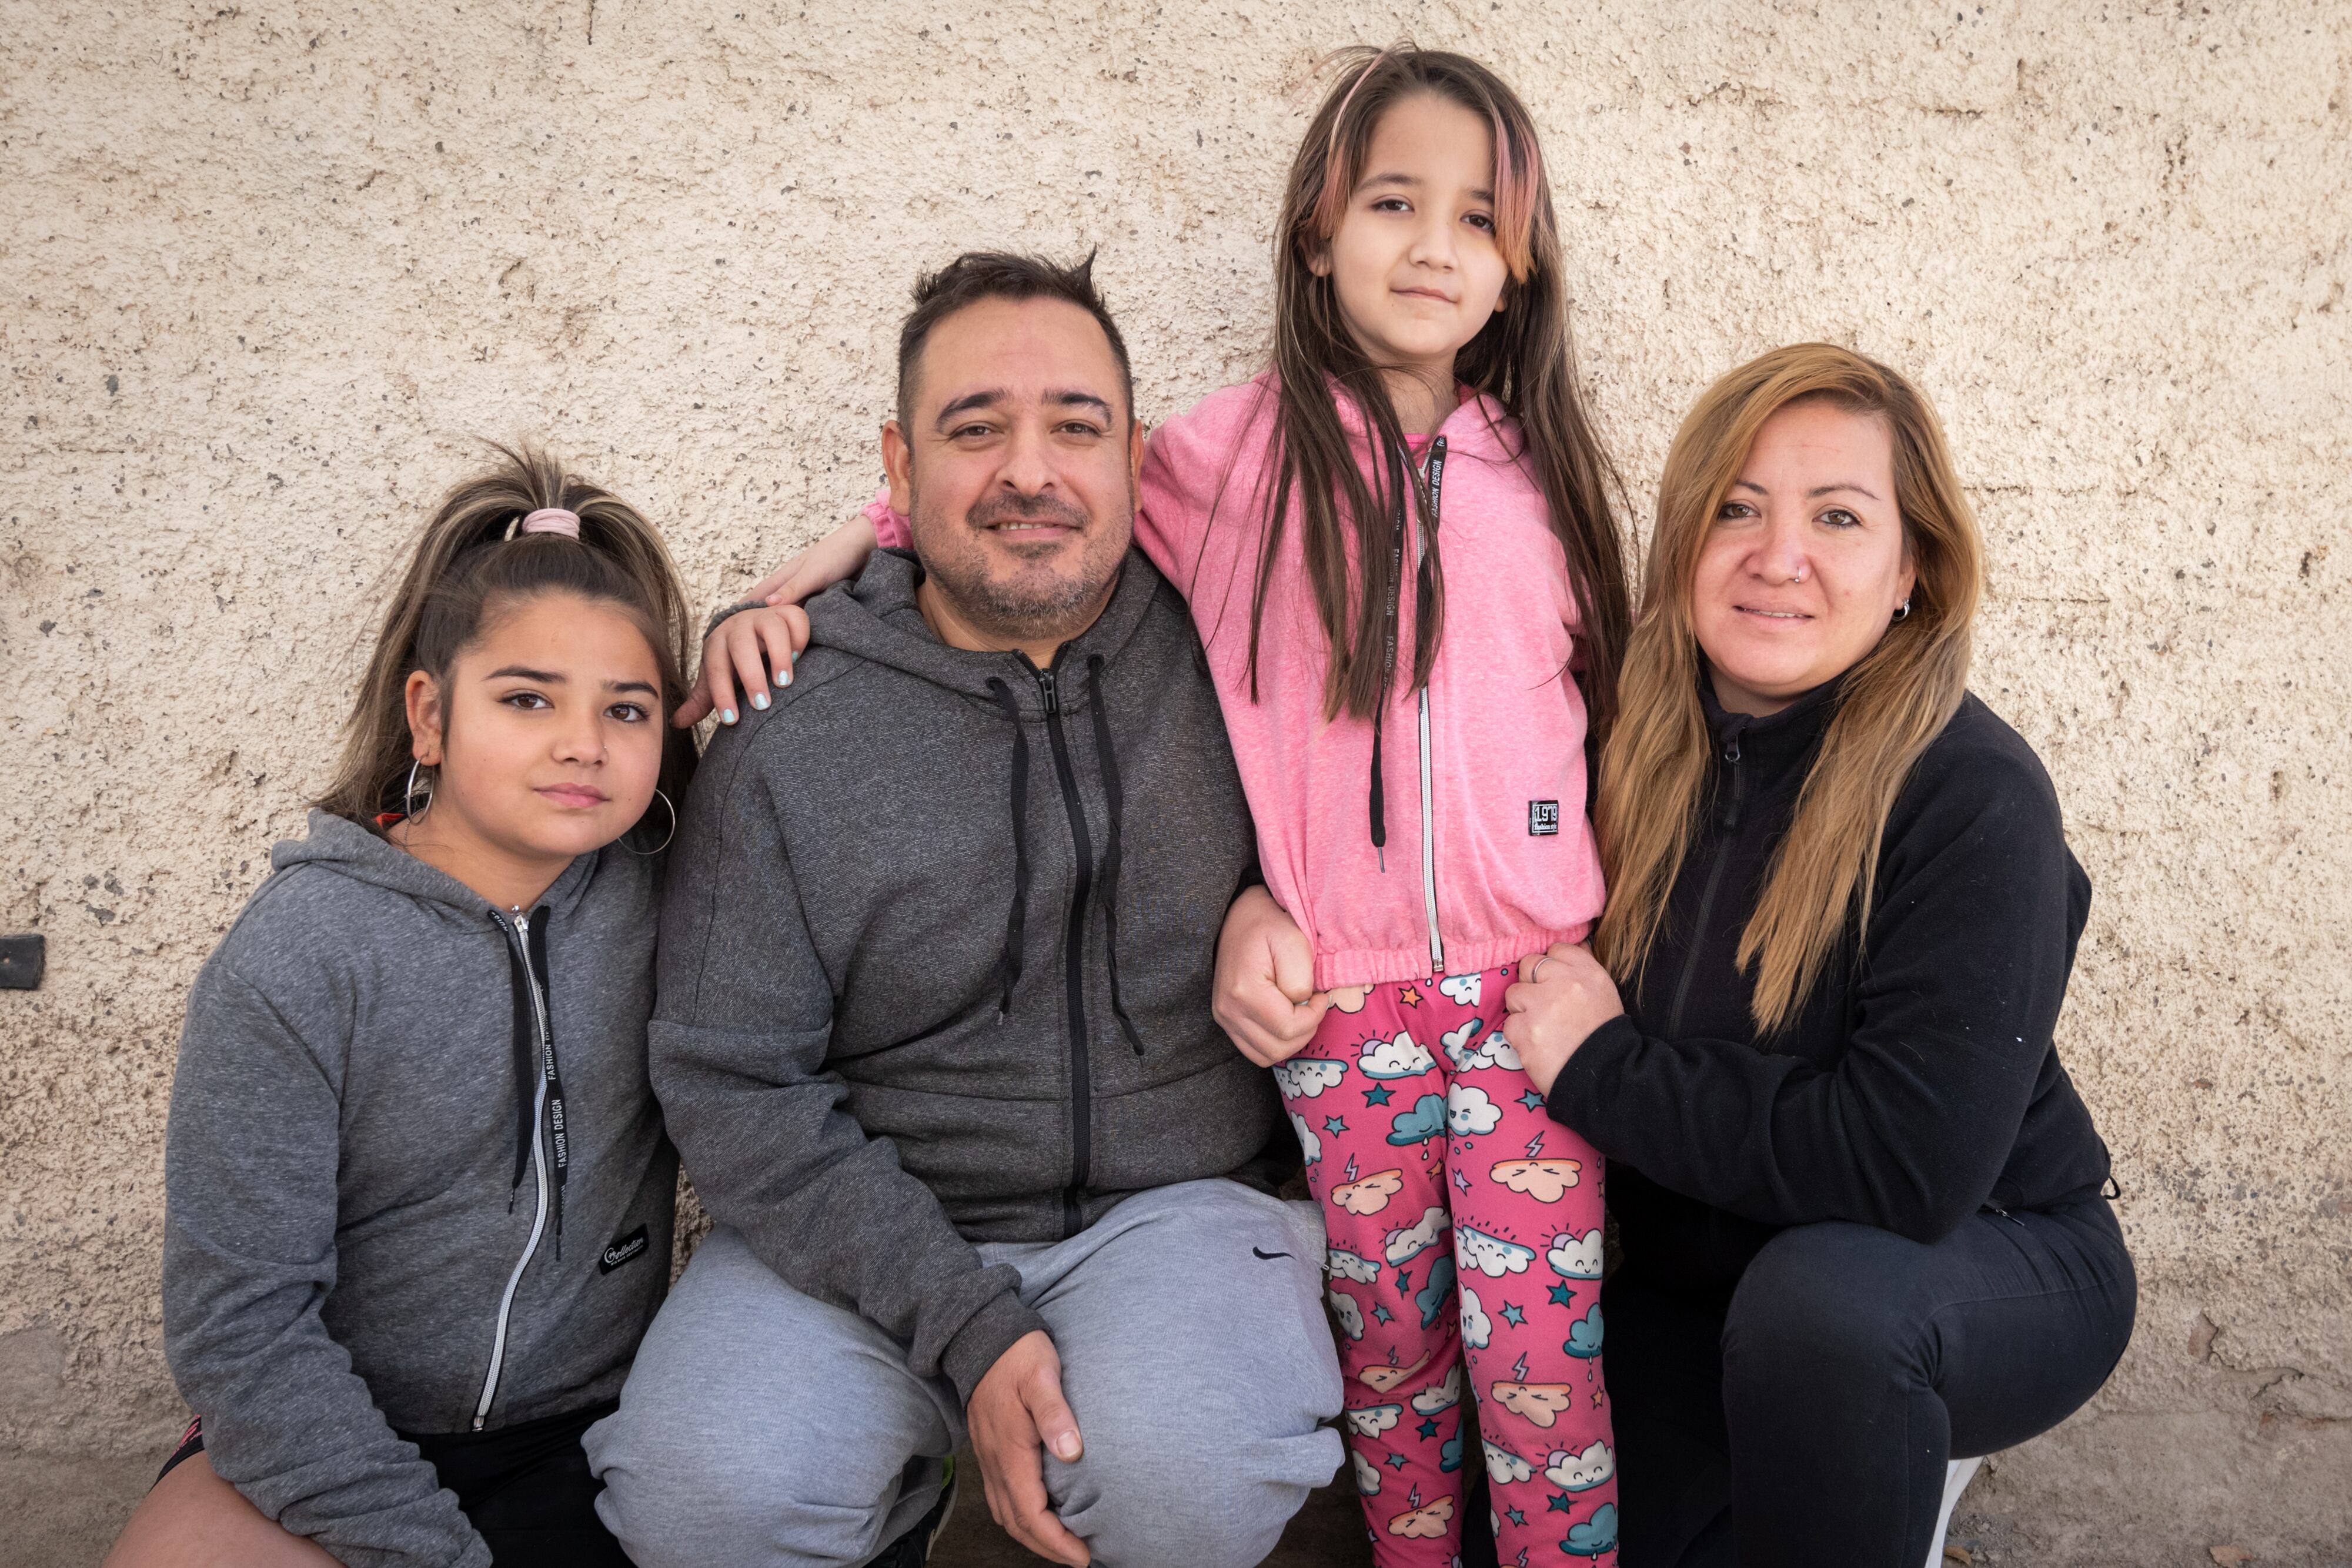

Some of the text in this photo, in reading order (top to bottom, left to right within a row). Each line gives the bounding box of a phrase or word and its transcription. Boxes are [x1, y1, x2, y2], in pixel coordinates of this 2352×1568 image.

[1431, 459, 1442, 517] FASHION DESIGN
[545, 1044, 556, 1080] FASHION
[552, 1099, 567, 1168] FASHION DESIGN
[604, 1237, 644, 1263] Collection
